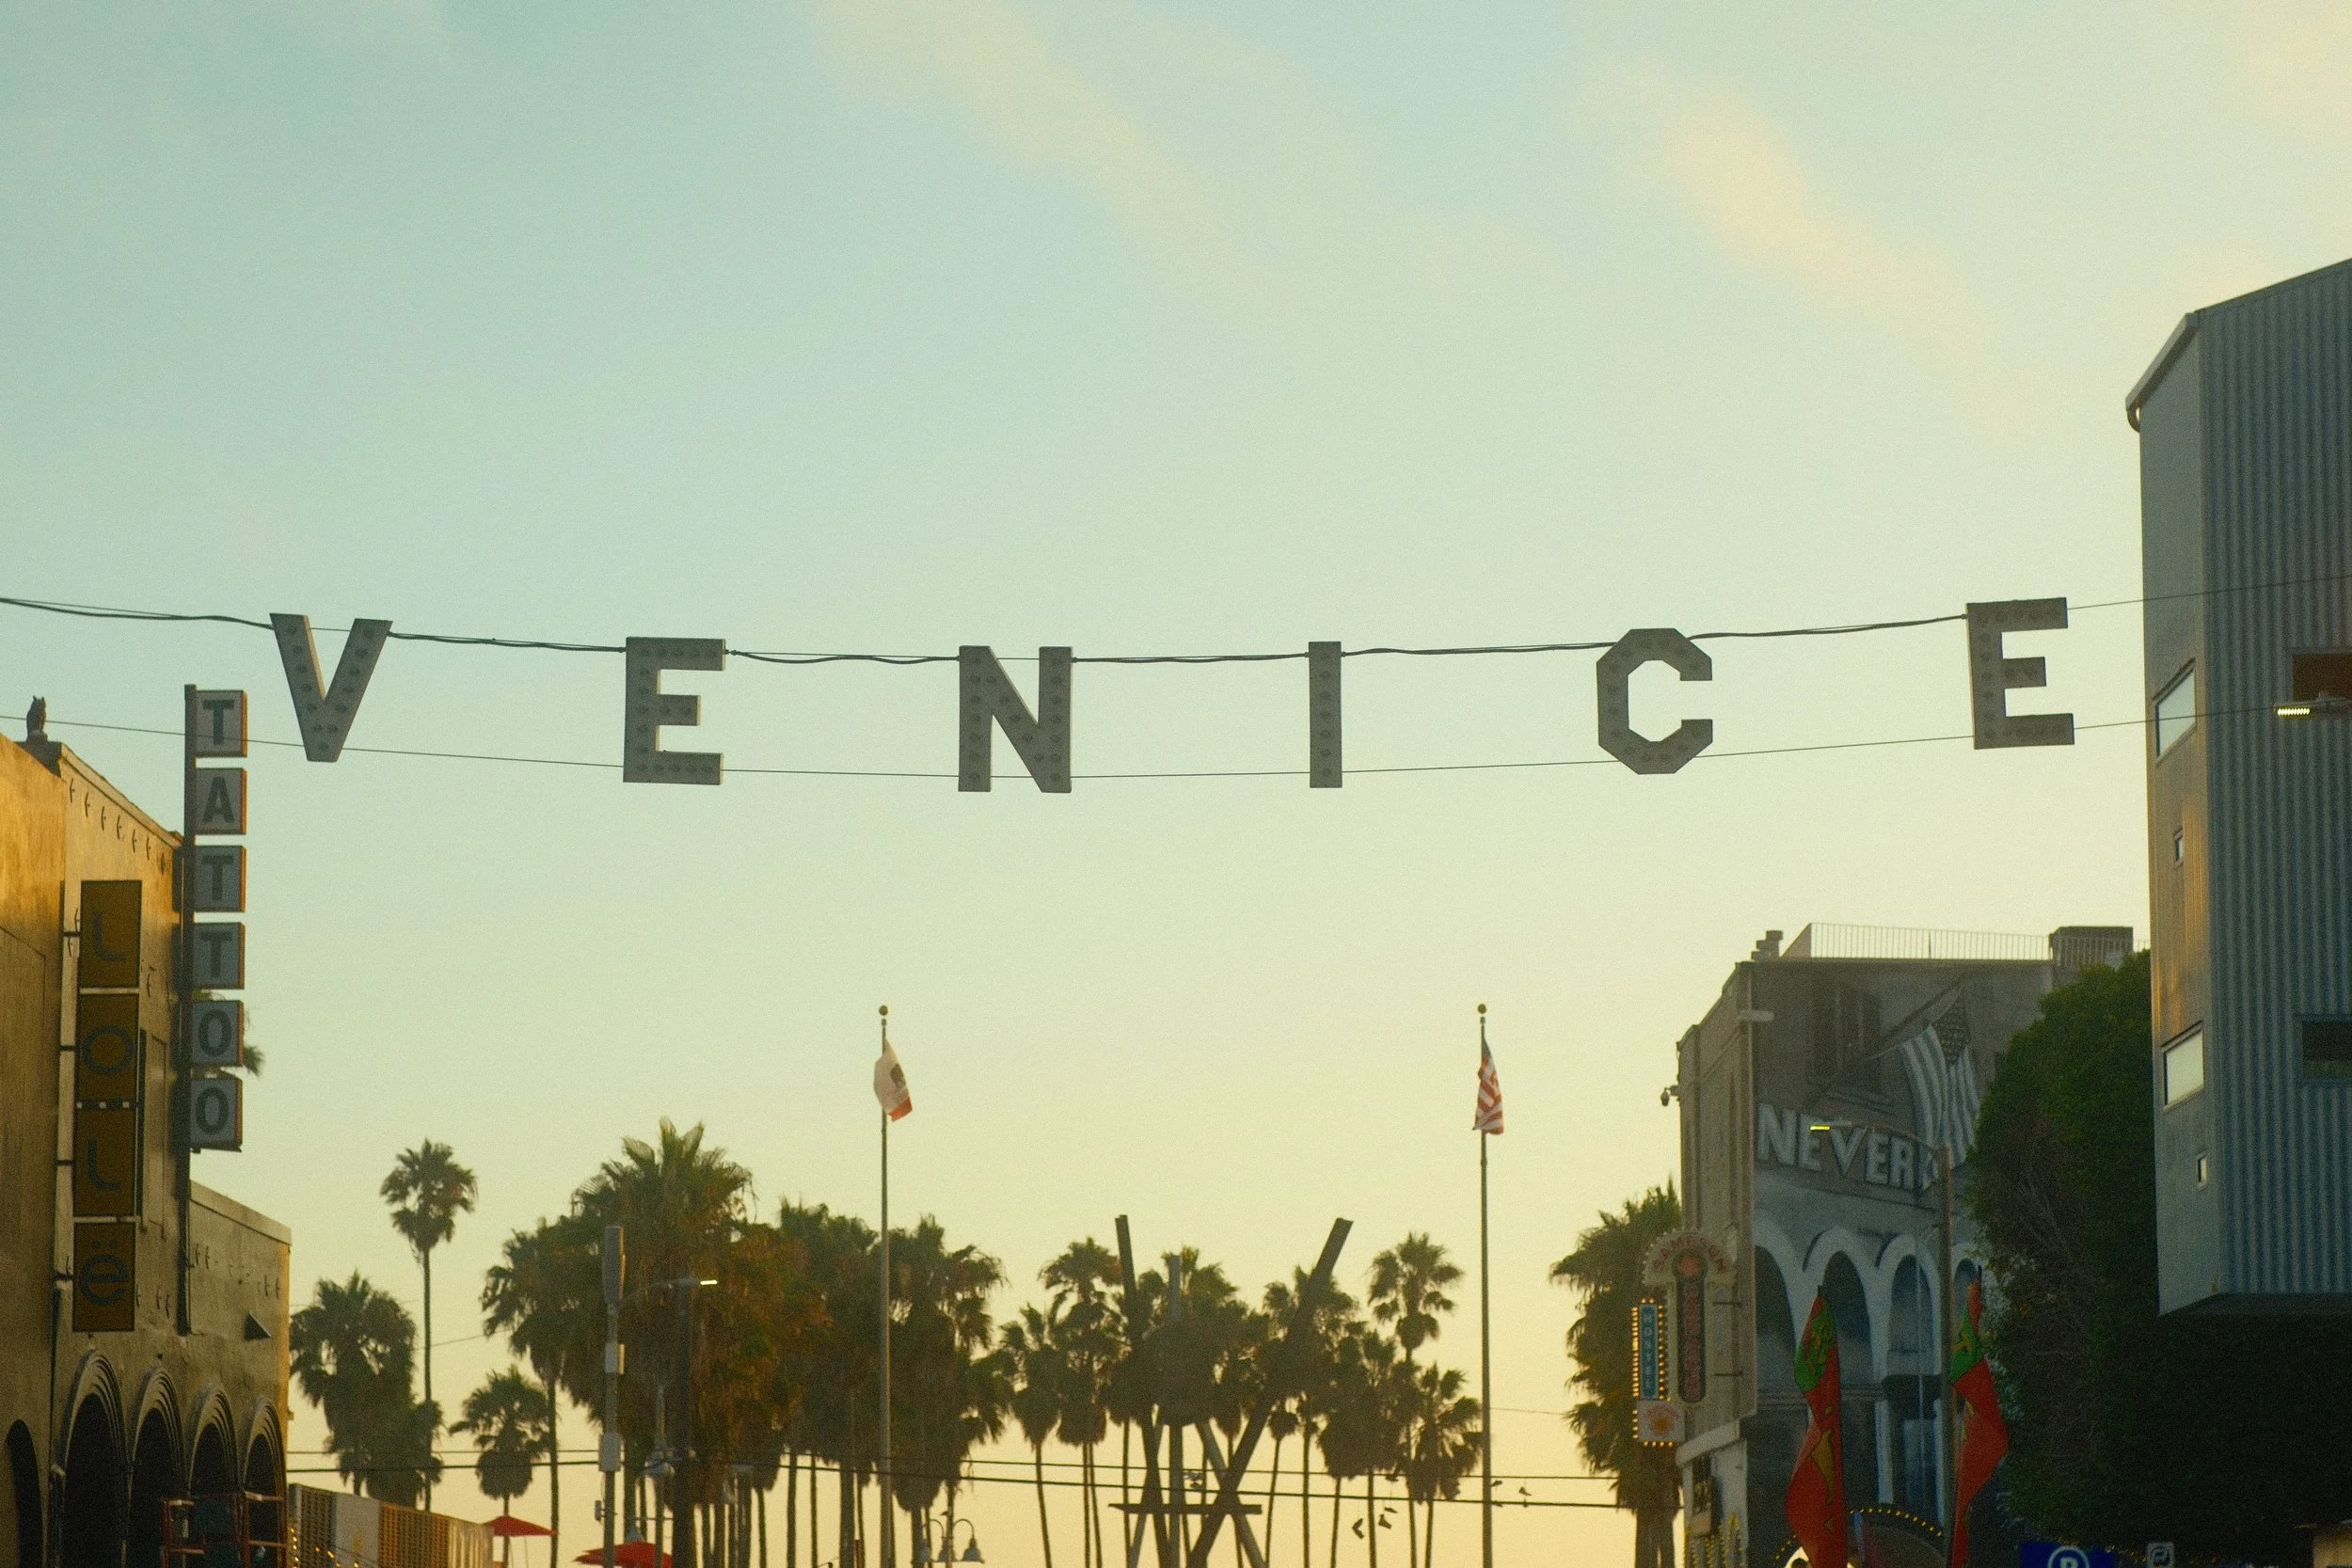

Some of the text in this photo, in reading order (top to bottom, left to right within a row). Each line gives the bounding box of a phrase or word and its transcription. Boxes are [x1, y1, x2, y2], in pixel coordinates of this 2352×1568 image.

[270, 597, 2074, 793] VENICE
[196, 699, 235, 1135] TATTOO
[1643, 1313, 1654, 1389] HOSTEL
